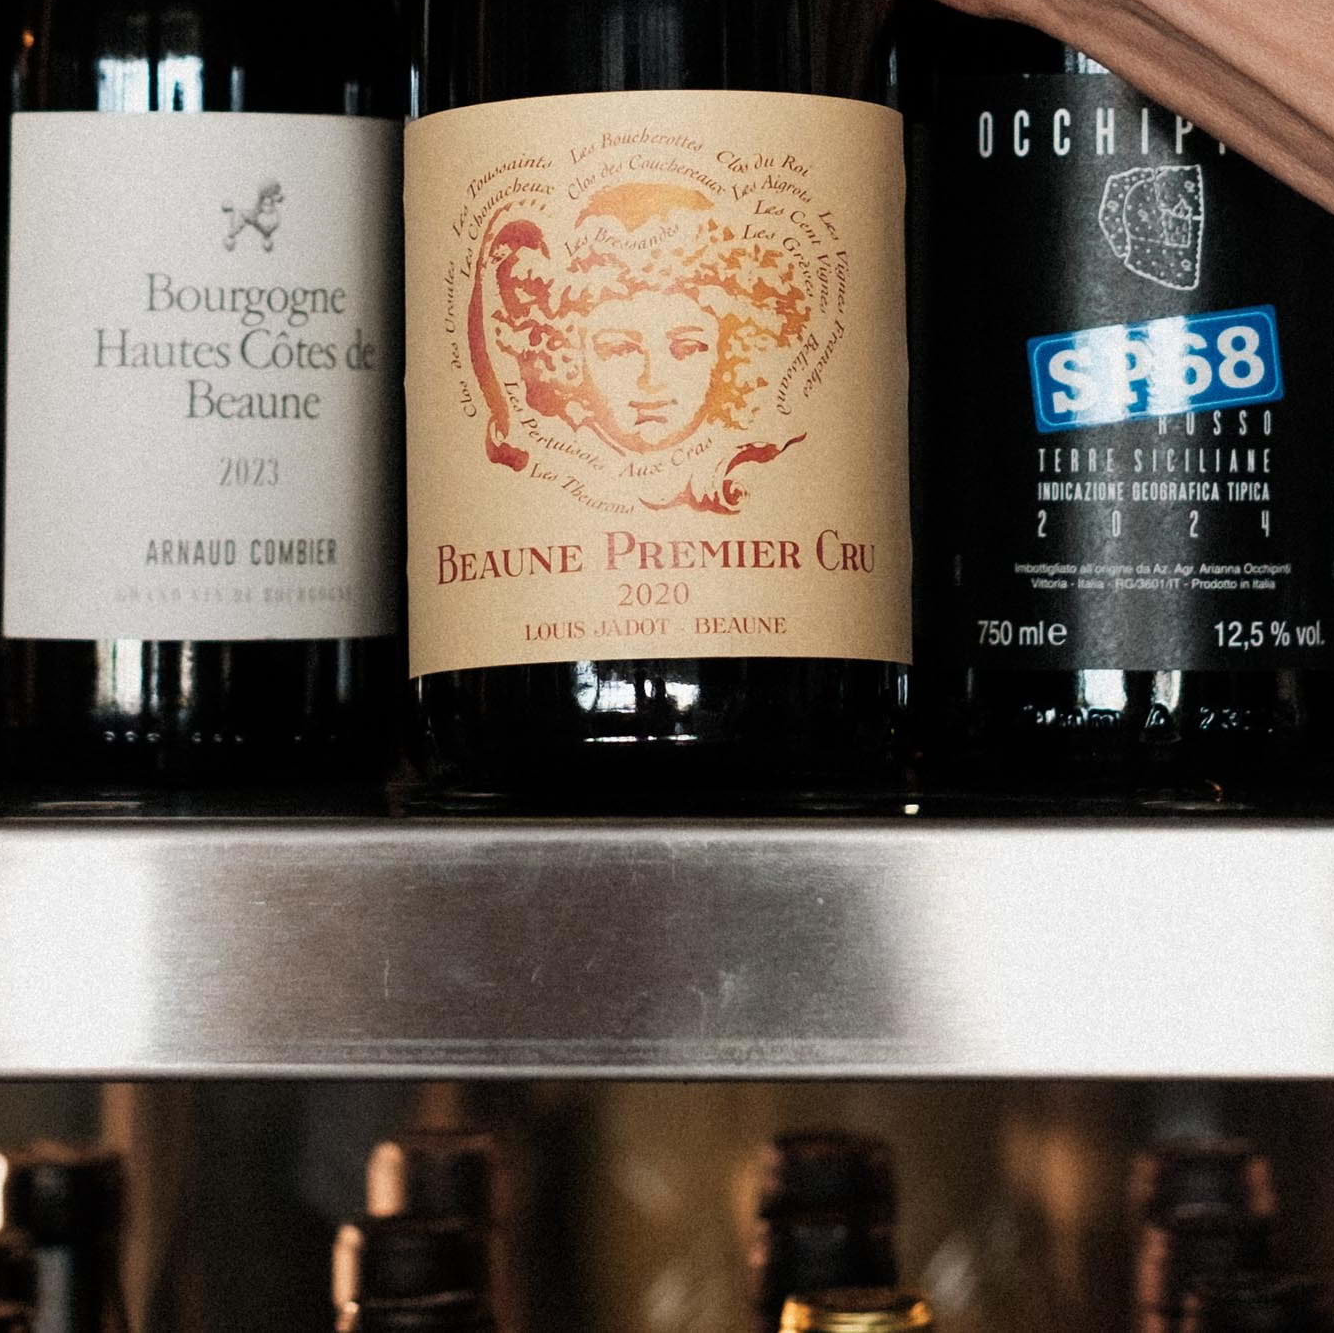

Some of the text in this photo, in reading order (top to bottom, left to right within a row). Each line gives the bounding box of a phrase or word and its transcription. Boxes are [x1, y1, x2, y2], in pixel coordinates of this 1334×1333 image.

[570, 127, 703, 165] Les Boucherottes
[978, 107, 1226, 159] OCCHIP
[467, 153, 553, 199] Toussaints
[568, 154, 726, 200] Clos des Couchereaux
[717, 150, 813, 177] Clos du Roi
[731, 173, 812, 203] Les Aigrots
[460, 178, 555, 279] Les Chouacheux
[564, 224, 679, 257] Les Bressandes
[742, 224, 776, 240] Les
[754, 200, 833, 314] Les Cent Vignes
[145, 272, 347, 328] Bourgogne
[802, 210, 850, 398] Les Vignes Franches
[94, 327, 377, 371] Hautes Côtes de
[444, 260, 477, 418] Clos des Ursules
[1048, 325, 1266, 414] SP68
[187, 379, 321, 419] Beaune
[503, 381, 605, 472] Les Pertuisots
[218, 456, 280, 487] 2023
[618, 436, 714, 478] Aux Cras
[1038, 448, 1272, 473] TERRE SICILIANE
[529, 462, 635, 515] Les Theurons
[1038, 481, 1270, 502] INDICAZIONE GEOGRAFICA TIPICA
[145, 538, 338, 566] ARNAUD COMBIER
[437, 528, 876, 585] BEAUNE PREMIER CRU
[1136, 562, 1151, 574] da
[1200, 562, 1241, 575] Arianna
[1243, 562, 1292, 577] Occhipinti
[617, 582, 690, 607] 2020
[1030, 577, 1068, 590] Vittoria
[1078, 577, 1104, 590] Italia
[1191, 577, 1238, 590] Prodotto
[1240, 577, 1250, 590] in
[1252, 577, 1276, 590] Italia
[525, 616, 787, 642] LOUIS JADOT BEAUNE
[977, 620, 1014, 646] 750
[1019, 620, 1044, 646] ml
[1214, 621, 1264, 651] 12,5
[1270, 621, 1291, 647] %
[1295, 621, 1326, 647] vol.
